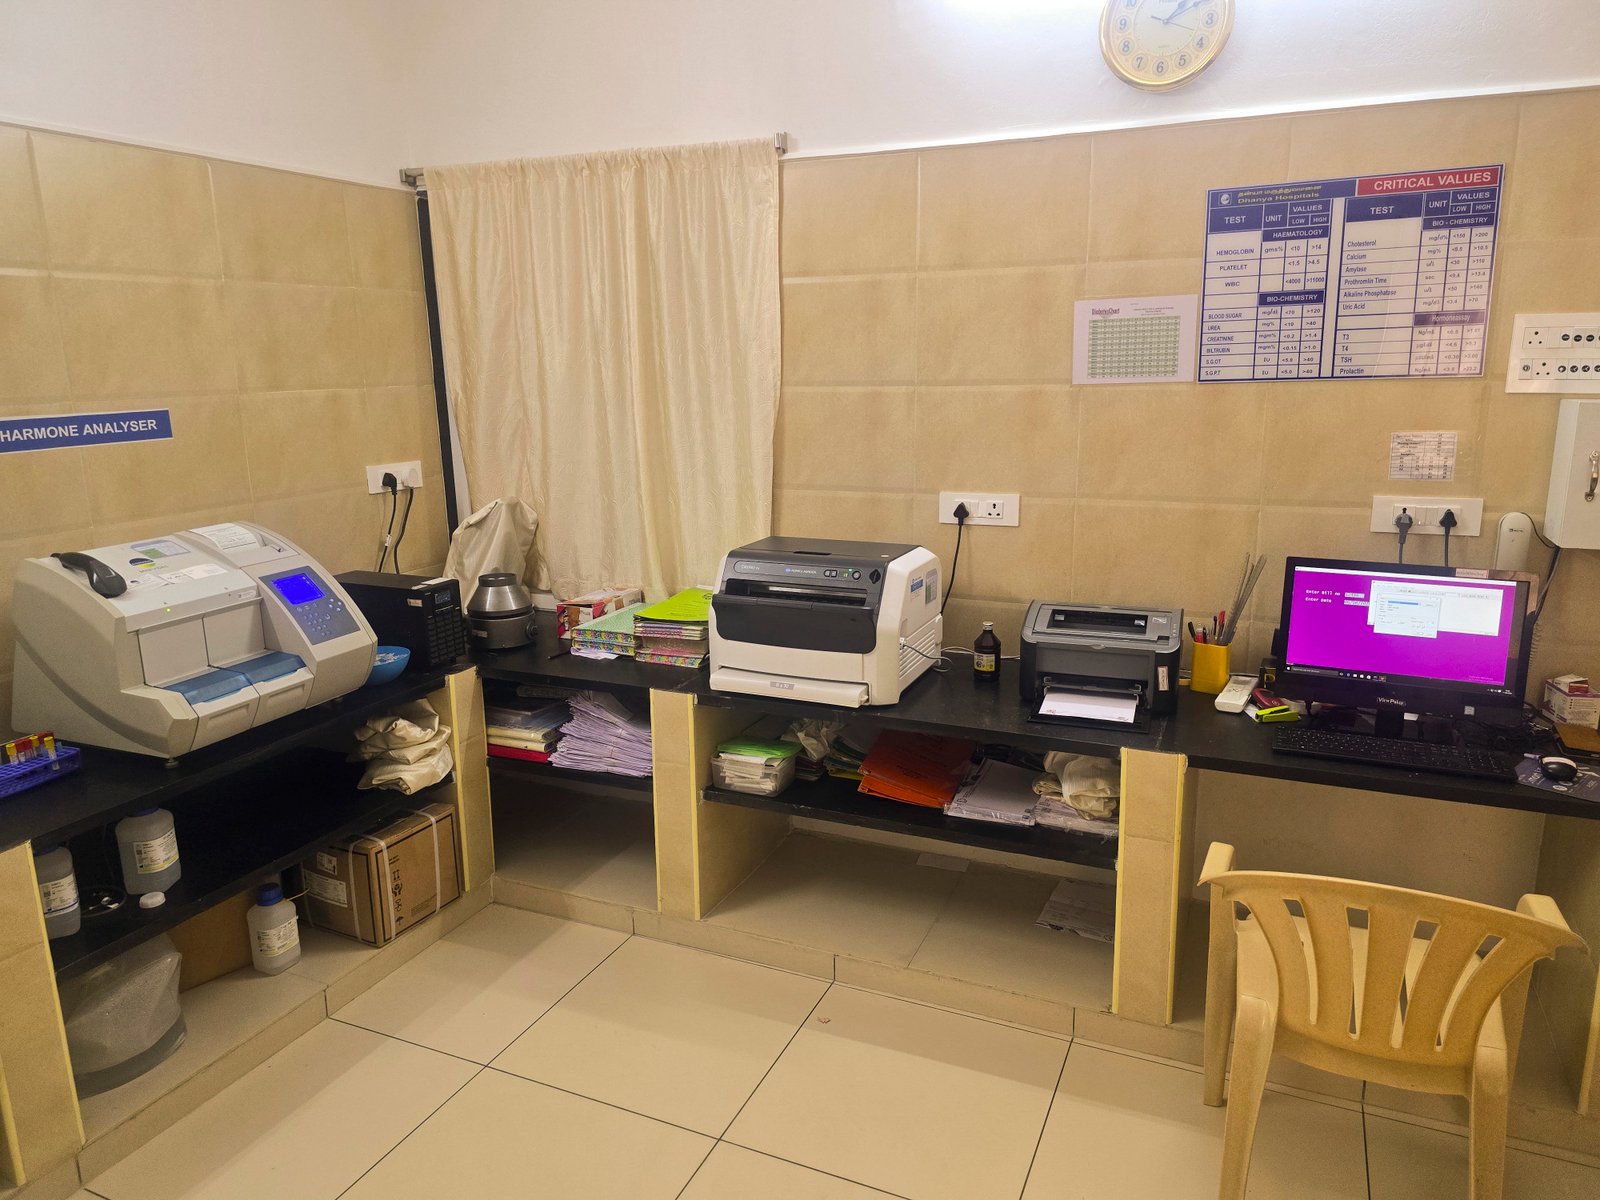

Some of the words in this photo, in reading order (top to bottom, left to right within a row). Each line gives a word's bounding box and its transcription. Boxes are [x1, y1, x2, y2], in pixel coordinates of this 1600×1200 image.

[1120, 18, 1127, 30] 9
[1206, 13, 1214, 25] 3
[1122, 40, 1130, 53] 8
[1196, 37, 1204, 48] 4
[1136, 57, 1143, 69] 7
[1156, 61, 1164, 73] 6
[1179, 55, 1187, 67] 5
[1373, 177, 1434, 191] CRITICAL
[1437, 171, 1492, 185] VALUES
[1238, 196, 1272, 204] Dhanya
[1275, 192, 1320, 202] Hospitals
[1370, 206, 1395, 215] TEST
[1428, 200, 1448, 208] UNIT
[1457, 192, 1490, 200] VALUES
[1224, 216, 1246, 224] TEST
[1449, 217, 1488, 226] CHEMISTRY
[1273, 229, 1323, 238] HAEMATOLOGY
[1347, 239, 1377, 248] Cholesterol
[1216, 248, 1254, 256] HEMOGLOBIN
[1345, 265, 1367, 274] Amylase
[1266, 294, 1318, 302] BIO-CHEMISTRY
[1343, 290, 1363, 298] Alkaline
[1364, 289, 1397, 299] Phosphatase
[1, 424, 79, 442] HARMONE
[83, 419, 158, 436] ANALYSER
